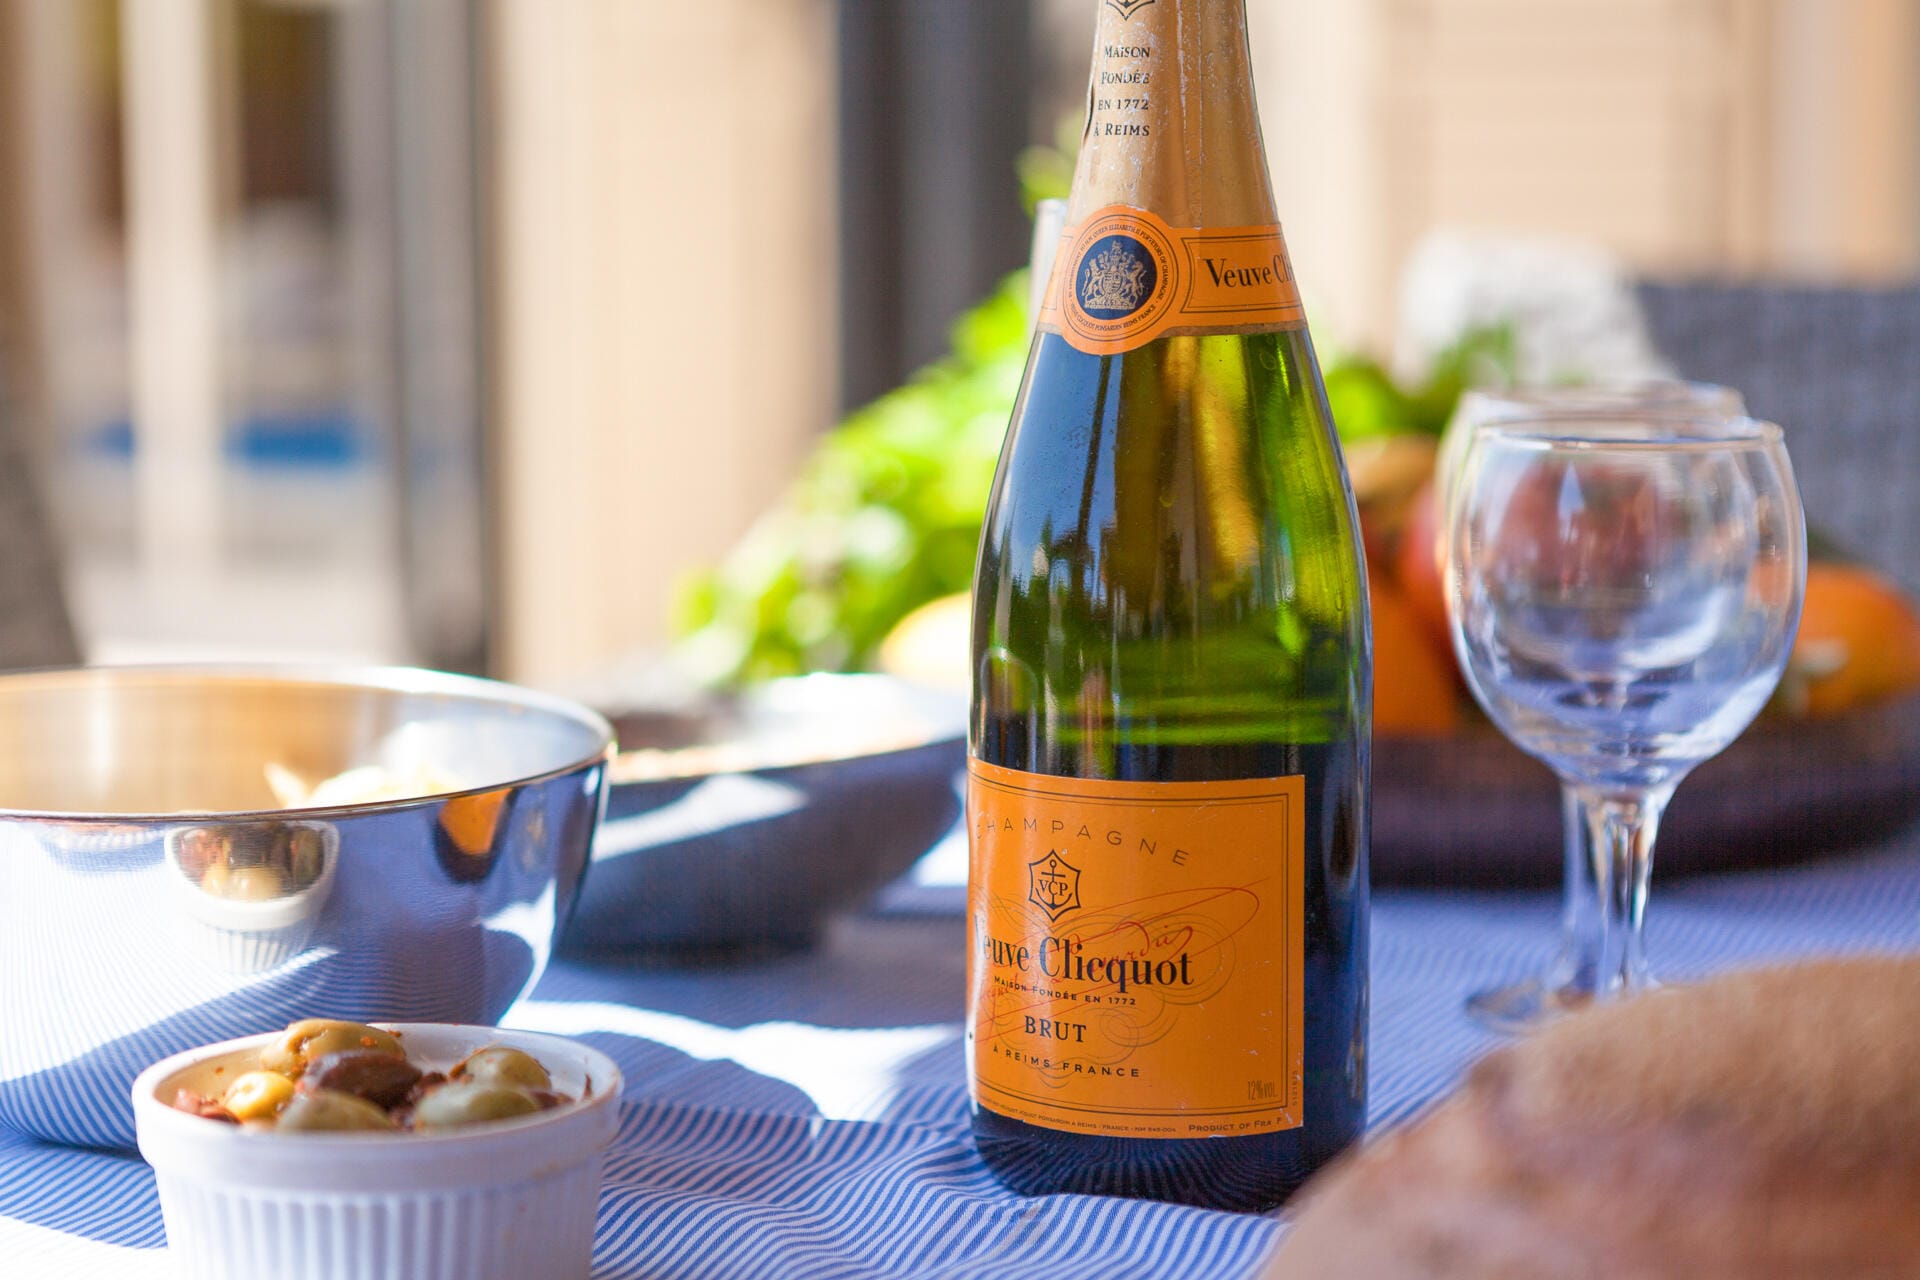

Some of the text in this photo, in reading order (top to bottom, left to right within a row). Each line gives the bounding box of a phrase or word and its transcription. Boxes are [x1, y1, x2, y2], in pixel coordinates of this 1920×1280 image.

[1104, 46, 1150, 58] MAISON
[1098, 98, 1149, 110] EN 1772
[1105, 123, 1150, 136] REIMS
[1108, 223, 1136, 233] ELIZABETH
[1157, 264, 1169, 300] CHAMPAGNE
[1203, 258, 1272, 288] Veuve
[1038, 879, 1069, 896] VCP
[1039, 936, 1195, 995] Clicquot
[994, 976, 1028, 991] MAISON
[1032, 985, 1077, 1001] FONDÉE
[1084, 994, 1101, 1004] EN
[1108, 996, 1137, 1006] 1772
[1024, 1015, 1087, 1043] BRUT
[1006, 1049, 1050, 1068] REIMS
[1062, 1062, 1140, 1077] FRANCE
[1102, 1123, 1129, 1131] FRANCE
[1188, 1123, 1234, 1133] PRODUCT
[1238, 1122, 1251, 1131] OF
